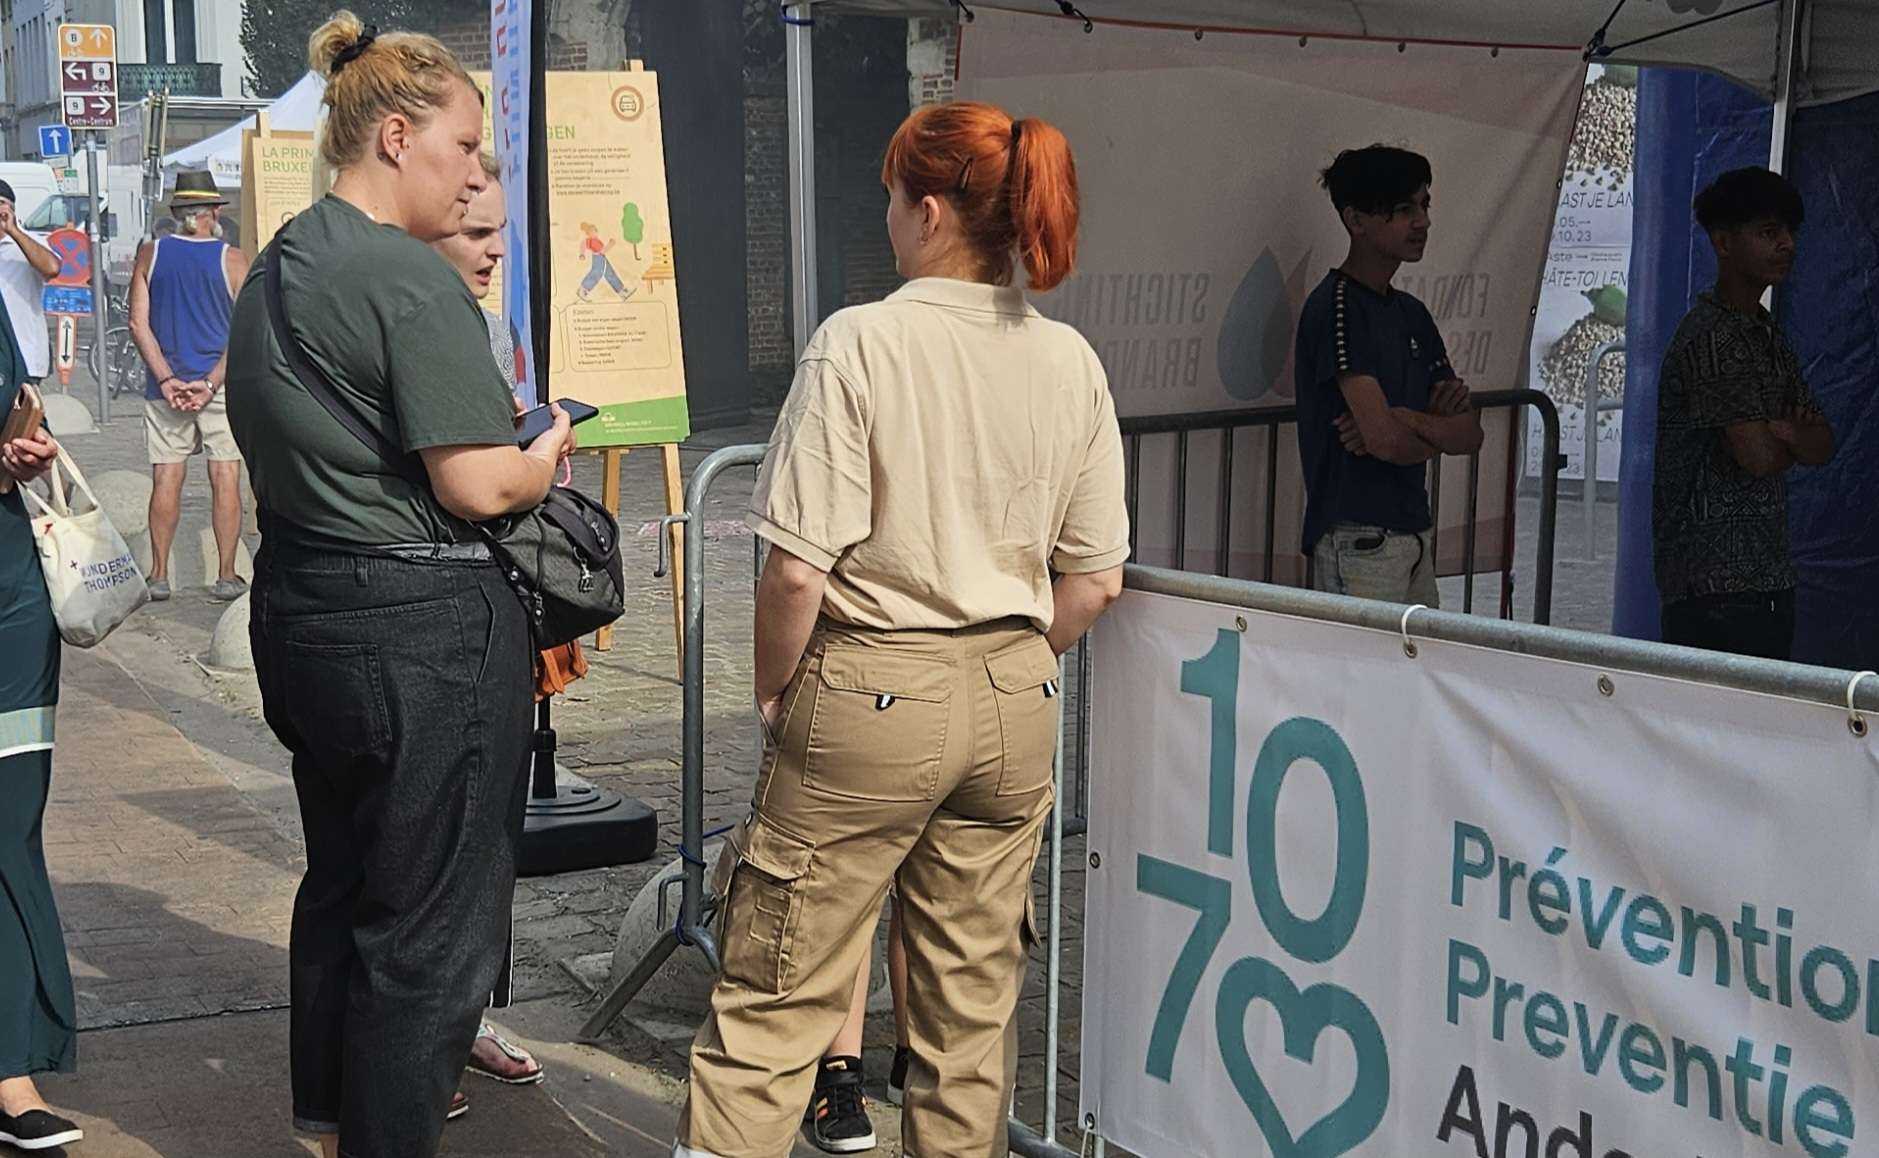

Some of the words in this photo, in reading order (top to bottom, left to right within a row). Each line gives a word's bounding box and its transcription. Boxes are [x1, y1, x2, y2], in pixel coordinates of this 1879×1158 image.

[262, 147, 279, 158] LA
[84, 566, 137, 593] THOMPSON
[1451, 820, 1879, 1037] Préventio
[1446, 938, 1856, 1158] Preventie
[1436, 1064, 1628, 1158] And
